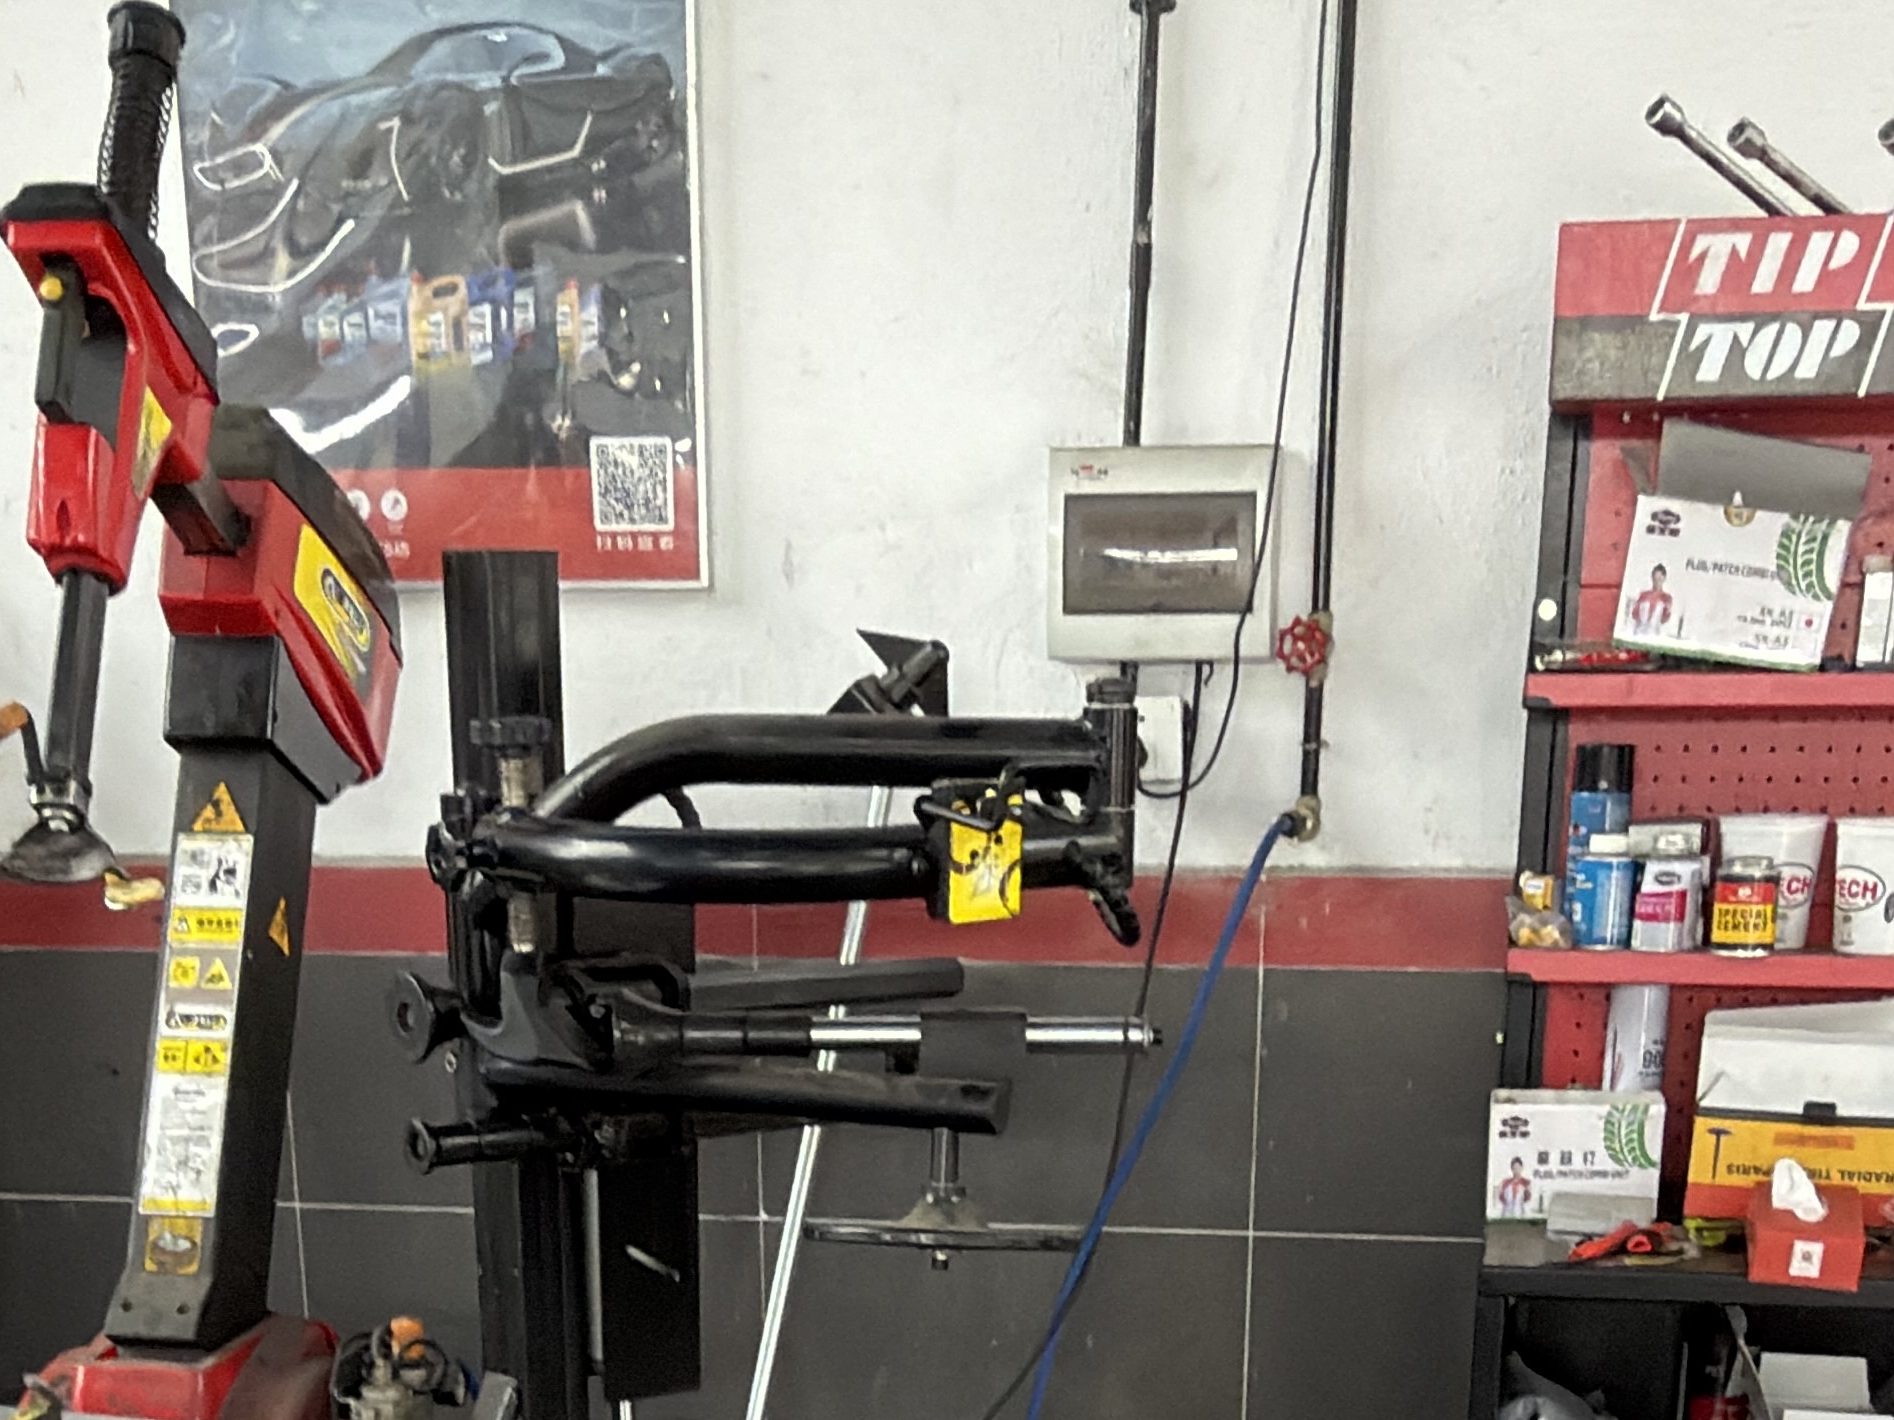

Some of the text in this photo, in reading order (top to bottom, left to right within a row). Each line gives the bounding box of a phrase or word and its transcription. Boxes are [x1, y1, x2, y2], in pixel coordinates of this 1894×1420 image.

[1688, 231, 1861, 295] TIP
[1691, 318, 1861, 381] TOP
[1836, 879, 1878, 900] ECH
